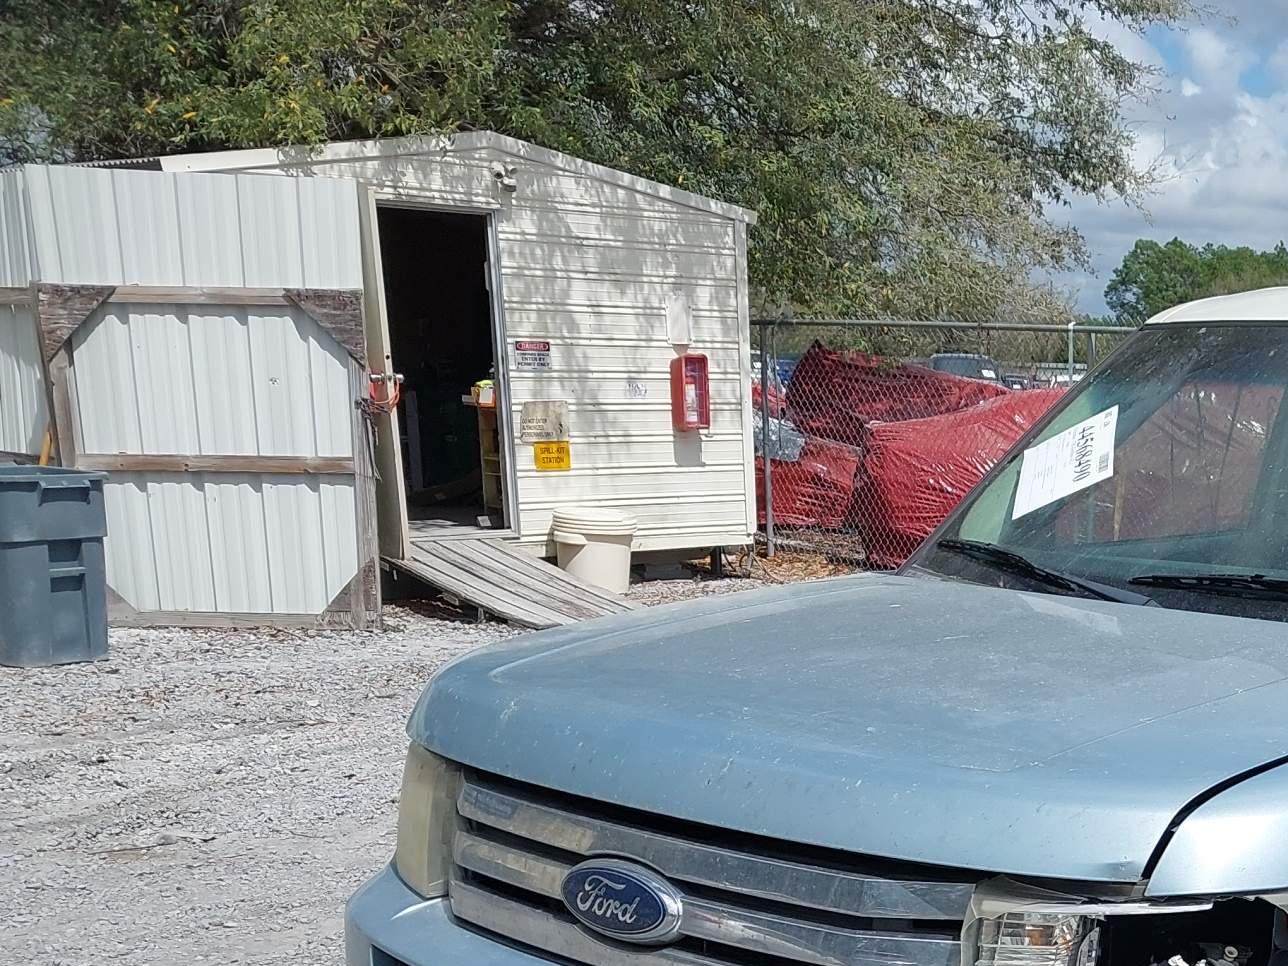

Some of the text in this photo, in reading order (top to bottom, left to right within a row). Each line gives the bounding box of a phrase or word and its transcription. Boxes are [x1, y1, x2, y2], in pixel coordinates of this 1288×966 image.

[521, 342, 545, 350] DANGER
[541, 456, 566, 464] STATION
[1072, 425, 1096, 483] 44568490
[576, 874, 641, 924] Ford
